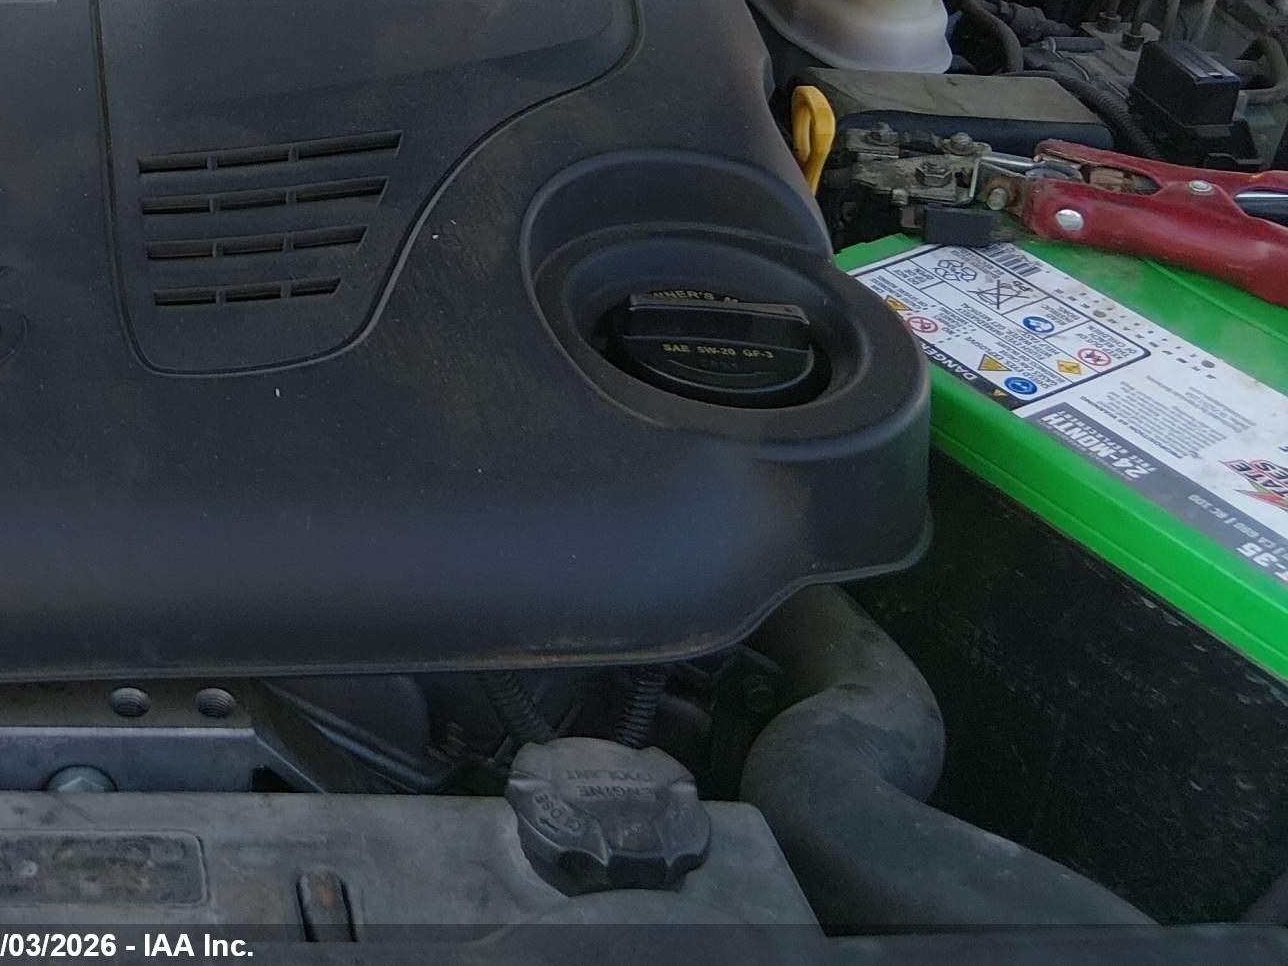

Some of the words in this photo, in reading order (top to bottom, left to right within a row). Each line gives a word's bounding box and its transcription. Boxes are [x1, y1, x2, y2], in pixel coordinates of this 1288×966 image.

[662, 342, 691, 354] SAE
[696, 345, 737, 357] 5W-20
[741, 348, 775, 359] GF-3
[1056, 409, 1129, 454] REPLACEMENT
[1039, 411, 1151, 479] 24-MONTH
[1126, 453, 1158, 472] FREE
[576, 784, 654, 797] ENGINE
